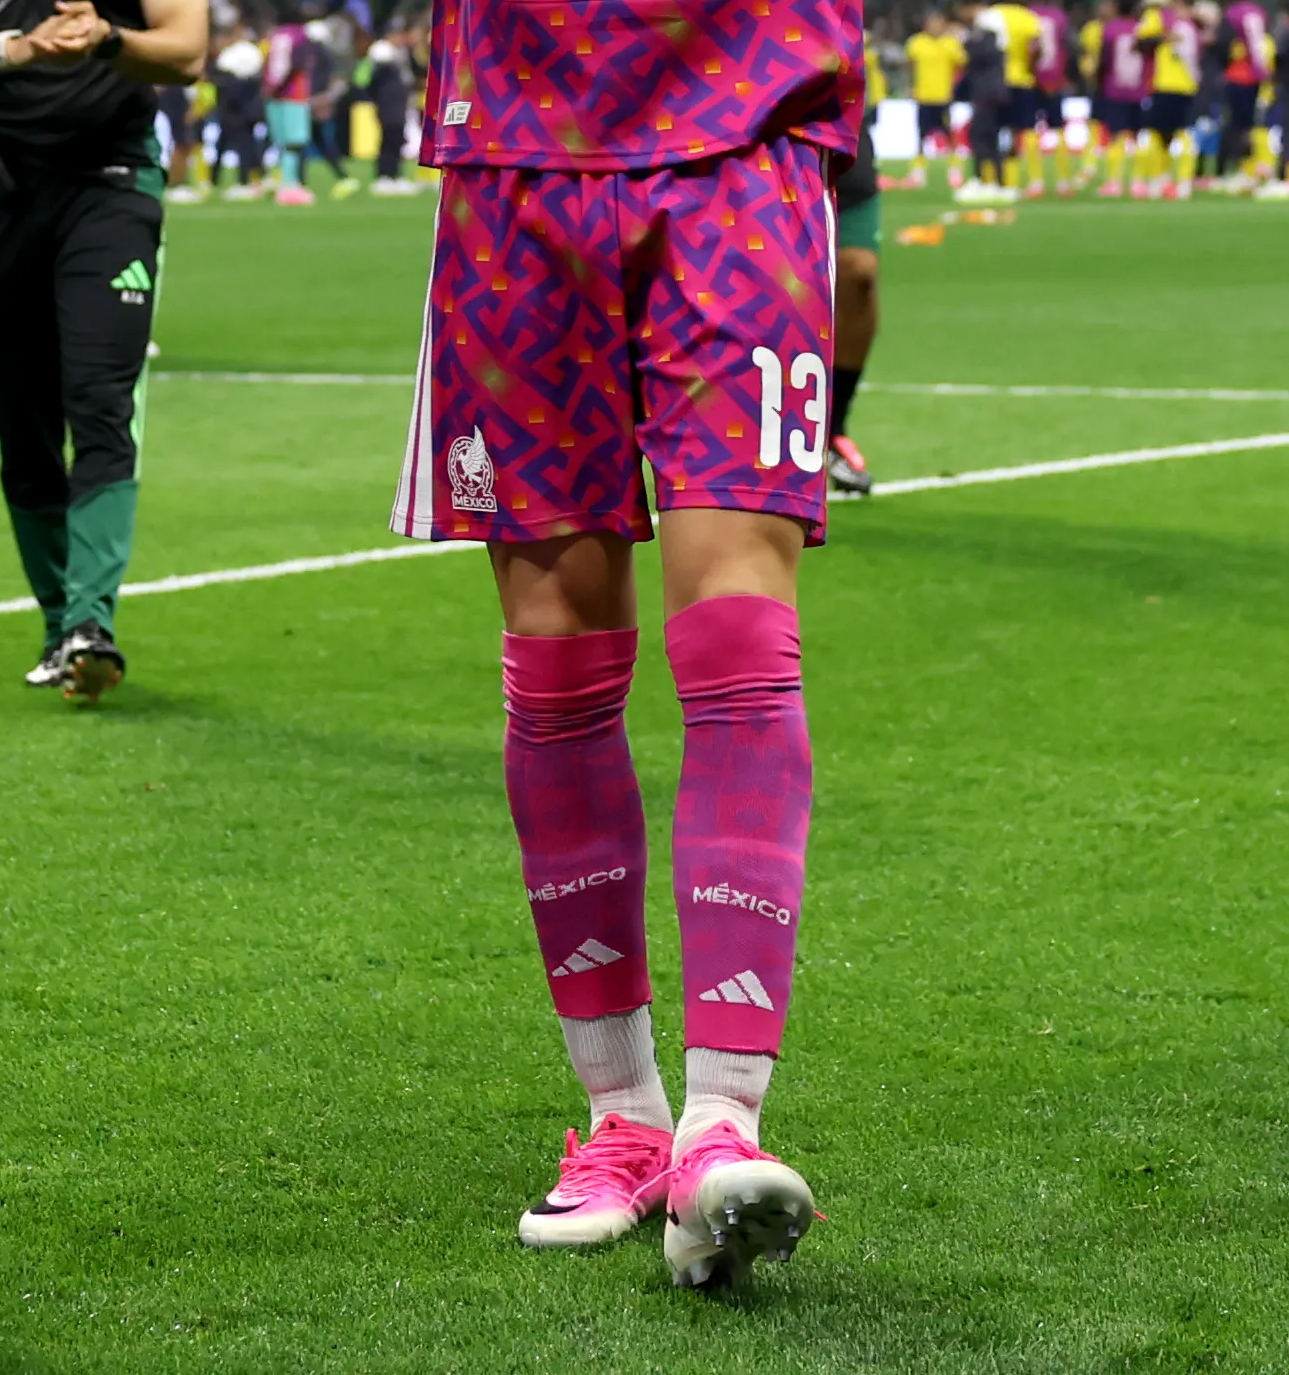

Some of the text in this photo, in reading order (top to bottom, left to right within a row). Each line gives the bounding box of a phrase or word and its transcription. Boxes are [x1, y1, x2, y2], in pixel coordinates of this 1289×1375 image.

[752, 346, 827, 473] 13
[454, 493, 494, 509] MÉXICO
[527, 866, 626, 902] MÉXICO
[692, 882, 791, 926] MÉXICO
